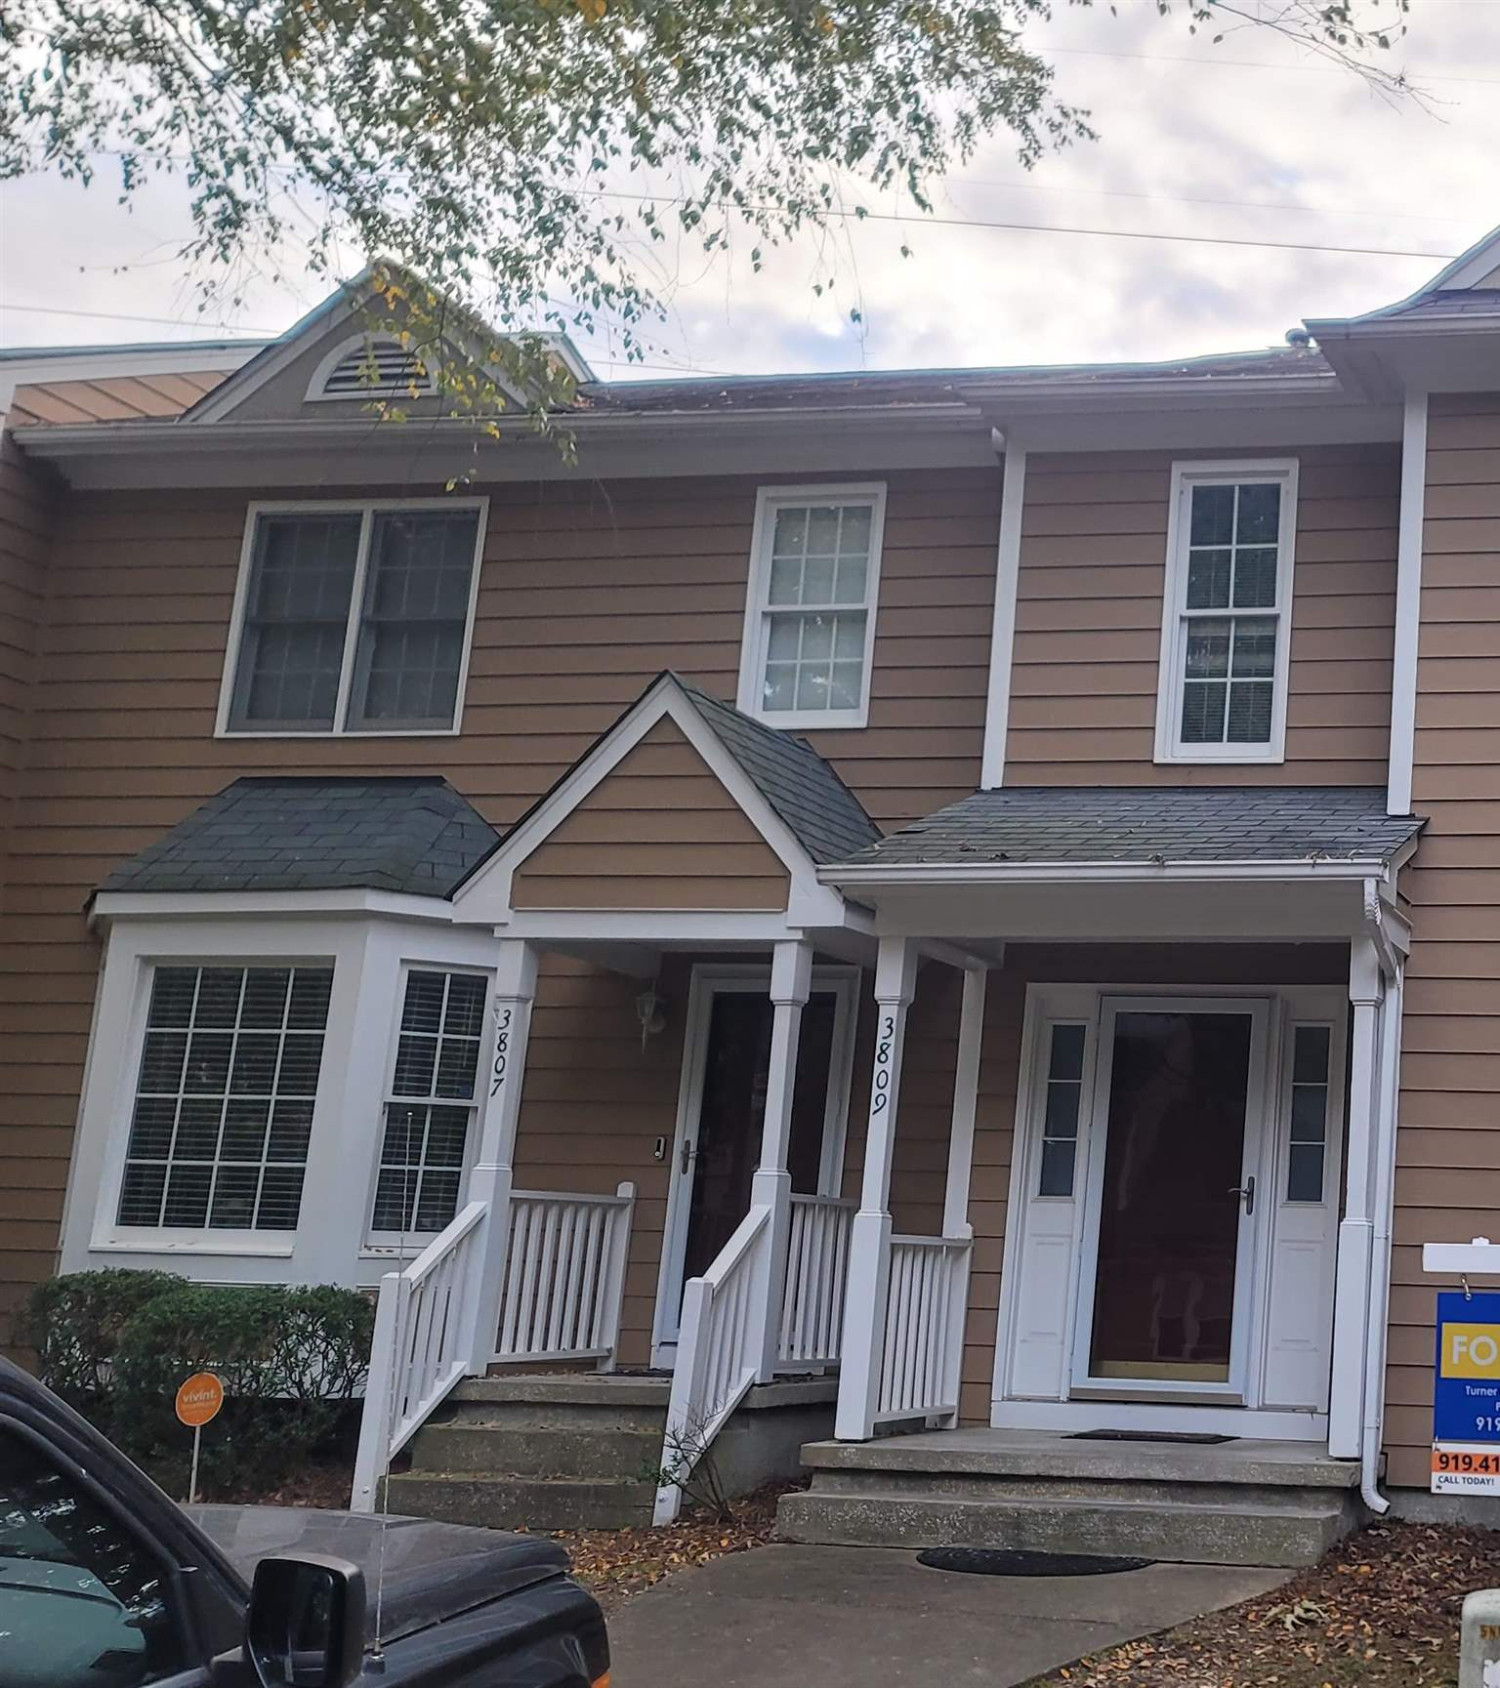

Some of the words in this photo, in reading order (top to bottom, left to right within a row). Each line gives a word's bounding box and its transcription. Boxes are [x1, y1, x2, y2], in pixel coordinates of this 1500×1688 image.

[491, 1009, 511, 1097] 3807
[872, 1017, 894, 1115] 3809
[1465, 1385, 1498, 1397] Turner
[1438, 1475, 1460, 1485] CALL
[1462, 1477, 1494, 1486] TODAY!
